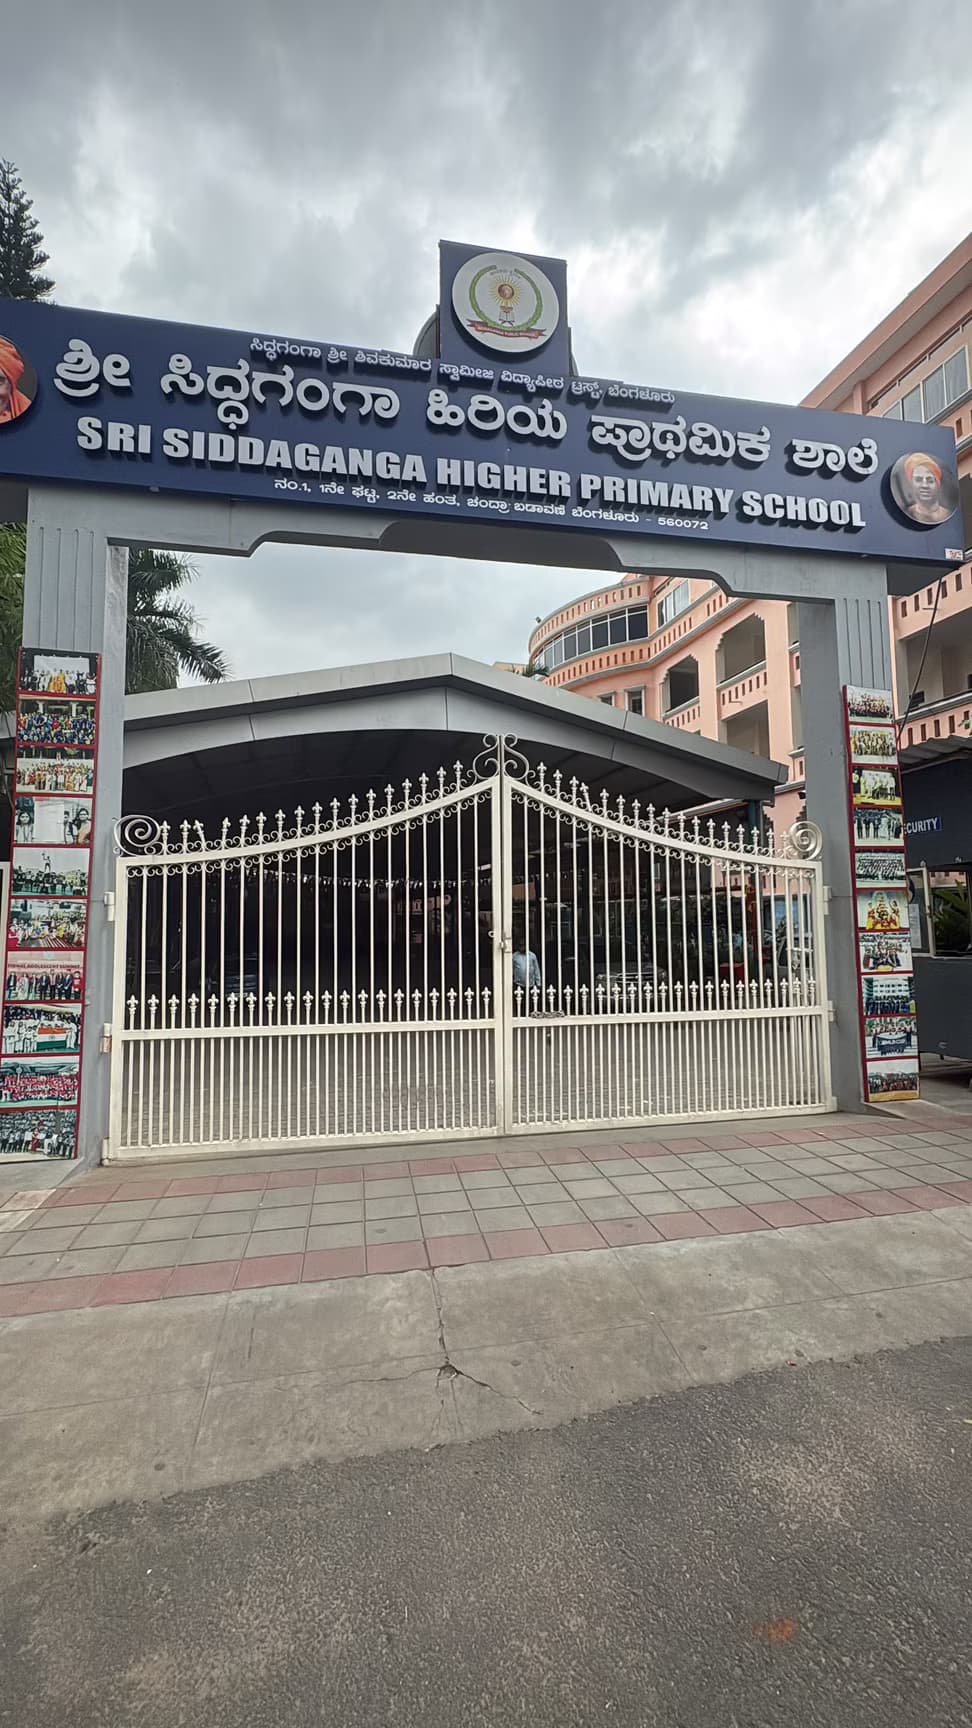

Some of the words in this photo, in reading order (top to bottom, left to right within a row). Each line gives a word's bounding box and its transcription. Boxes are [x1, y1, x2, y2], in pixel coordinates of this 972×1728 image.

[53, 338, 132, 398] ಶ್ರೀ
[160, 353, 401, 430] ಸಿದ್ಧಗಂಗಾ
[426, 389, 568, 441] ಹಿರಿಯ
[591, 415, 771, 462] ಪ್ರಾಥಮಿಕ
[791, 435, 879, 476] ಶಾಲೆ
[250, 337, 322, 362] ಸಿದ್ಧಗಂಗಾ
[327, 347, 348, 364] ಶ್ರೀ
[354, 350, 432, 371] ಶಿವಕುಮಾರ
[608, 384, 675, 402] ಬೆಂಗಳೂರು
[77, 416, 151, 454] SRI
[162, 428, 427, 483] SIDDAGANGA
[436, 457, 572, 498] HIGHER
[580, 473, 735, 514] PRIMARY
[742, 490, 866, 528] SCHOOL
[319, 481, 345, 495] 1ನೇ
[387, 487, 416, 502] 2ನೇ
[571, 506, 639, 523] ಬೆಂಗಳೂರು
[657, 517, 709, 530] 560072
